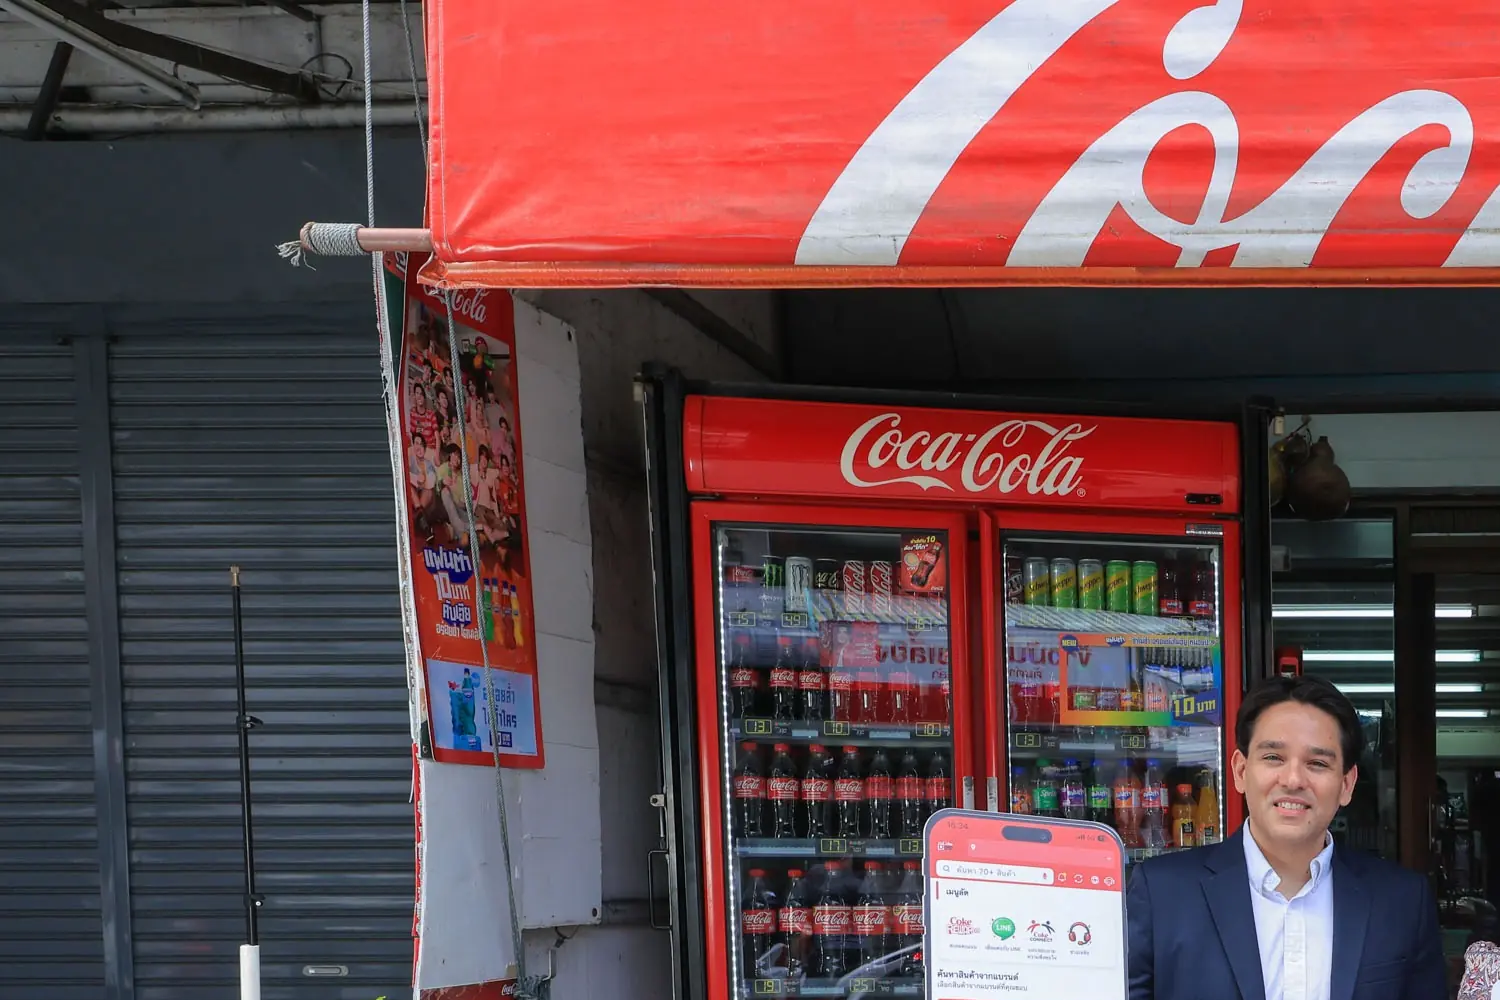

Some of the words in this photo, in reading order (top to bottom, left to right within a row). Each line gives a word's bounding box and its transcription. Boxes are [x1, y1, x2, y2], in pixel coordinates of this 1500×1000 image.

[840, 412, 1099, 497] Coca-Cola
[433, 572, 452, 601] 10
[785, 614, 801, 624] 49
[1174, 697, 1195, 717] 10
[1197, 700, 1216, 713] บาท
[1023, 734, 1035, 746] 13
[907, 840, 919, 850] 13
[899, 910, 923, 925] Coca-C
[950, 916, 973, 926] Coke
[996, 924, 1012, 933] LINE
[763, 980, 775, 992] 19
[853, 979, 869, 990] 25
